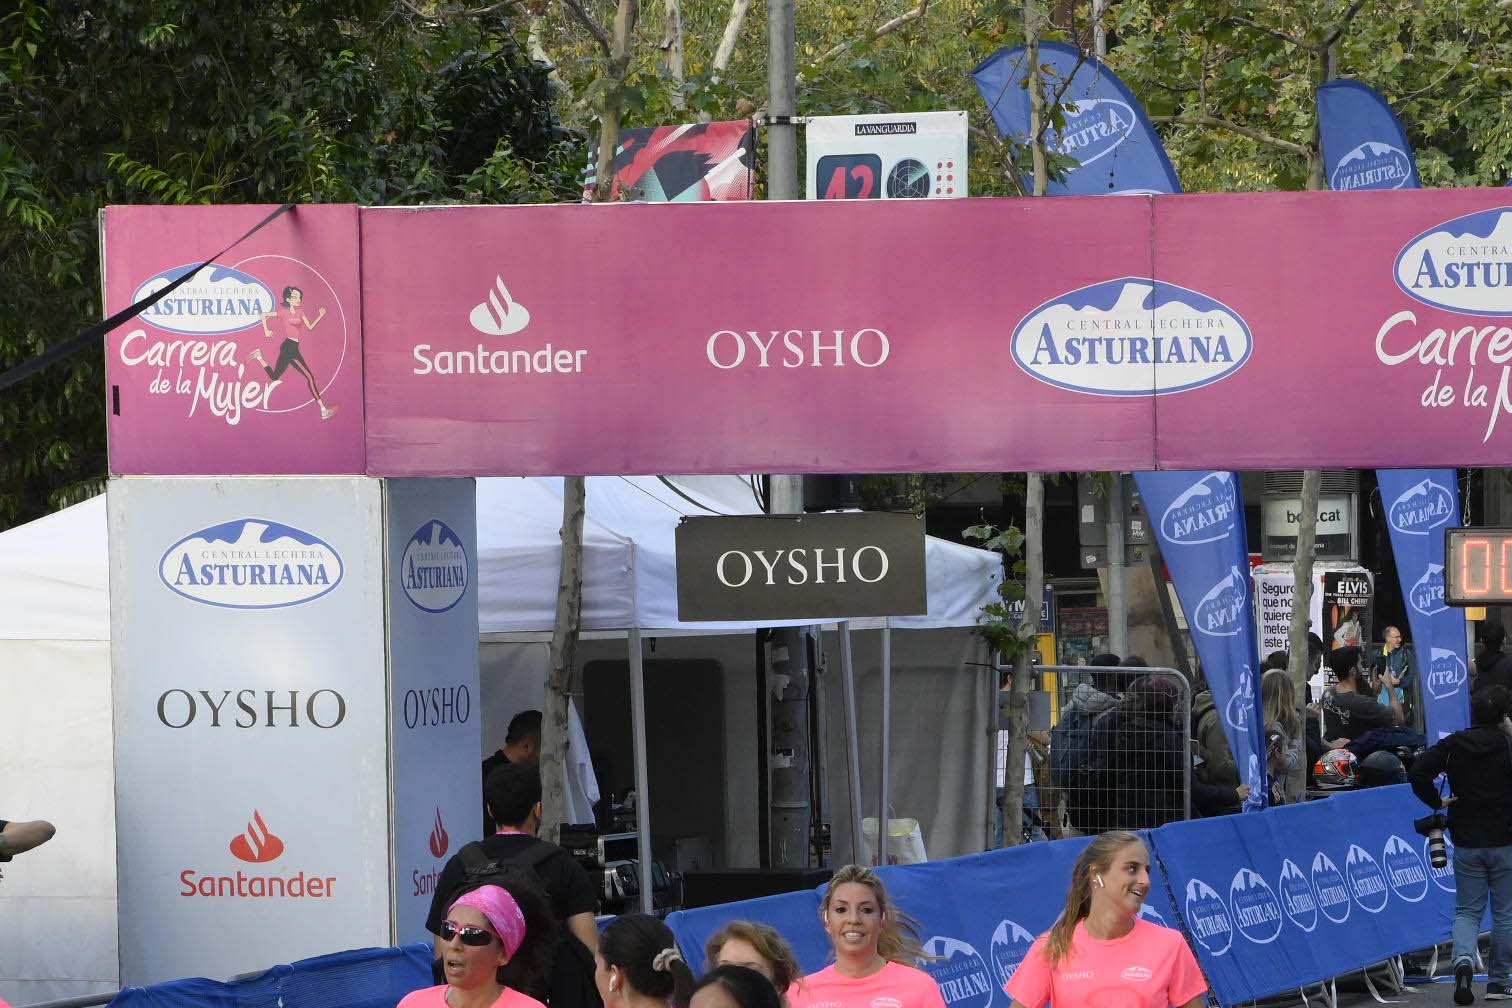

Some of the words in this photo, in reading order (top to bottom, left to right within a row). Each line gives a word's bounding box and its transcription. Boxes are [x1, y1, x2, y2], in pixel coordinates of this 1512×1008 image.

[857, 125, 866, 134] LA
[866, 123, 915, 134] VANGUARDIA
[172, 287, 207, 295] ENTRAL
[213, 287, 260, 295] LECHERA
[1067, 319, 1140, 330] CENTRAL
[1150, 318, 1226, 329] LECHERA
[120, 329, 238, 368] Carrera
[414, 343, 588, 375] Santander
[706, 328, 890, 369] OYSHO
[1030, 322, 1233, 366] ASTURIANA
[149, 368, 172, 395] de
[175, 367, 191, 395] la
[189, 360, 282, 426] Mujer
[1421, 369, 1455, 408] de
[1462, 368, 1487, 408] la
[174, 552, 331, 586] ASTURIANA
[201, 550, 258, 560] CENTRAL
[266, 550, 324, 559] LECHERA
[407, 549, 465, 590] ASTURIANA
[716, 545, 889, 587] OYSHO
[1337, 581, 1368, 594] ELVIS
[1263, 598, 1278, 609] que
[1264, 610, 1291, 623] quiere
[1265, 638, 1282, 647] este
[156, 688, 346, 730] OYSHO
[403, 684, 470, 730] OYSHO
[180, 869, 336, 898] Santander
[1351, 874, 1386, 898] ASTURIANA
[1389, 863, 1426, 887] ASTURIANA
[1235, 900, 1280, 928] ASTURIANA
[940, 971, 991, 1004] URIANA
